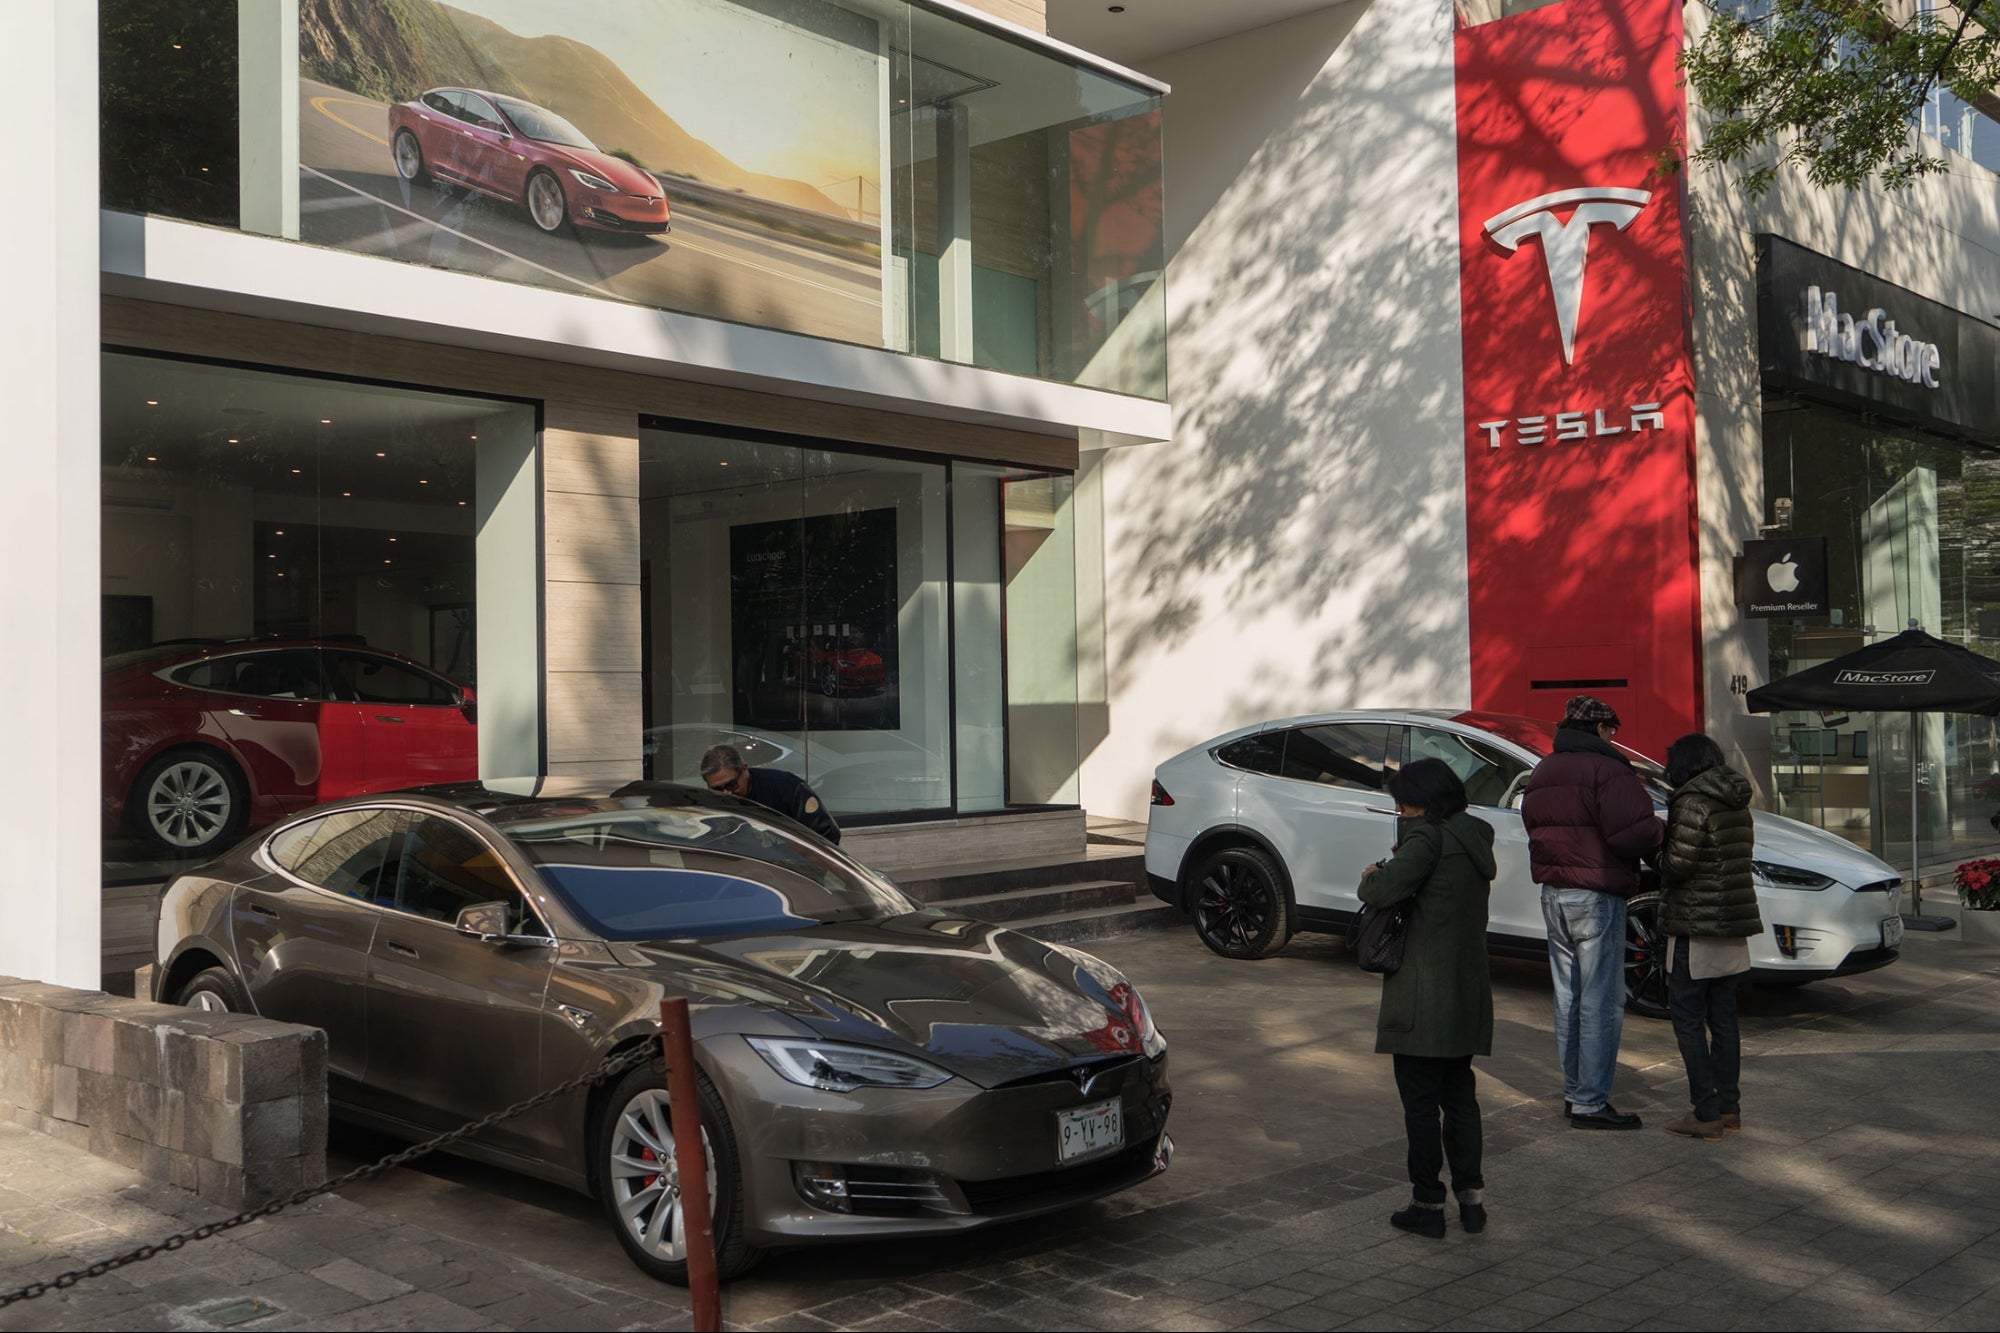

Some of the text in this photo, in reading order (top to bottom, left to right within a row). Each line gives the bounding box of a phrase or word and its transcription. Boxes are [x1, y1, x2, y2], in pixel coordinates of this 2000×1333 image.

[1806, 285, 1941, 389] MacStore
[1478, 402, 1664, 448] TESLA
[1750, 602, 1818, 612] Premium Reseller
[1730, 675, 1748, 695] 419
[1842, 672, 1927, 683] MacStore
[1064, 1113, 1117, 1145] 9-YV-98
